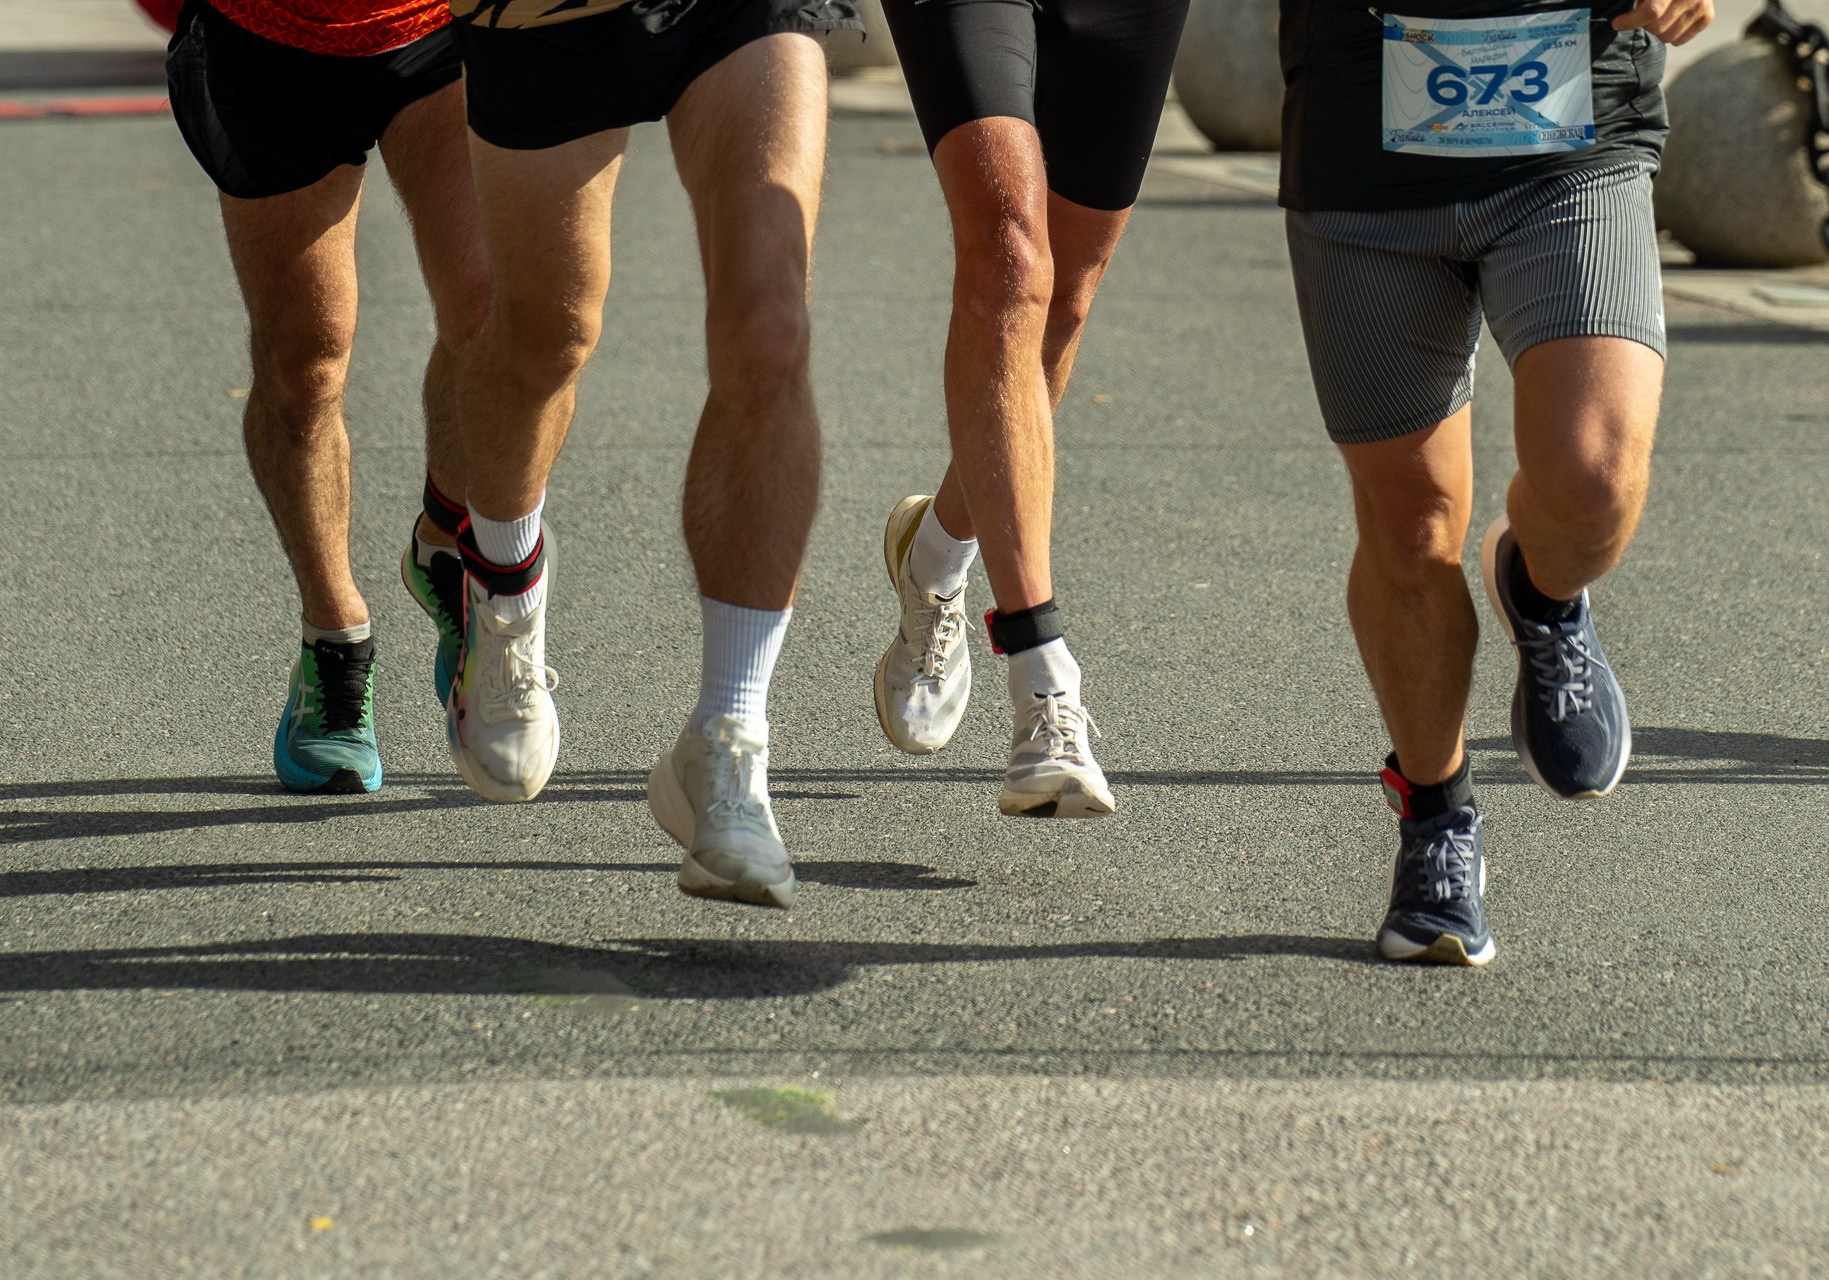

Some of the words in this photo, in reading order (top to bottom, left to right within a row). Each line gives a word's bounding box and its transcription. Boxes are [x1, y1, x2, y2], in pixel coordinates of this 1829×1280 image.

[1427, 61, 1548, 107] 673
[1462, 107, 1516, 118] АЛЕКСЕЙ
[1539, 127, 1584, 141] СЕНЕЖСКАЯ
